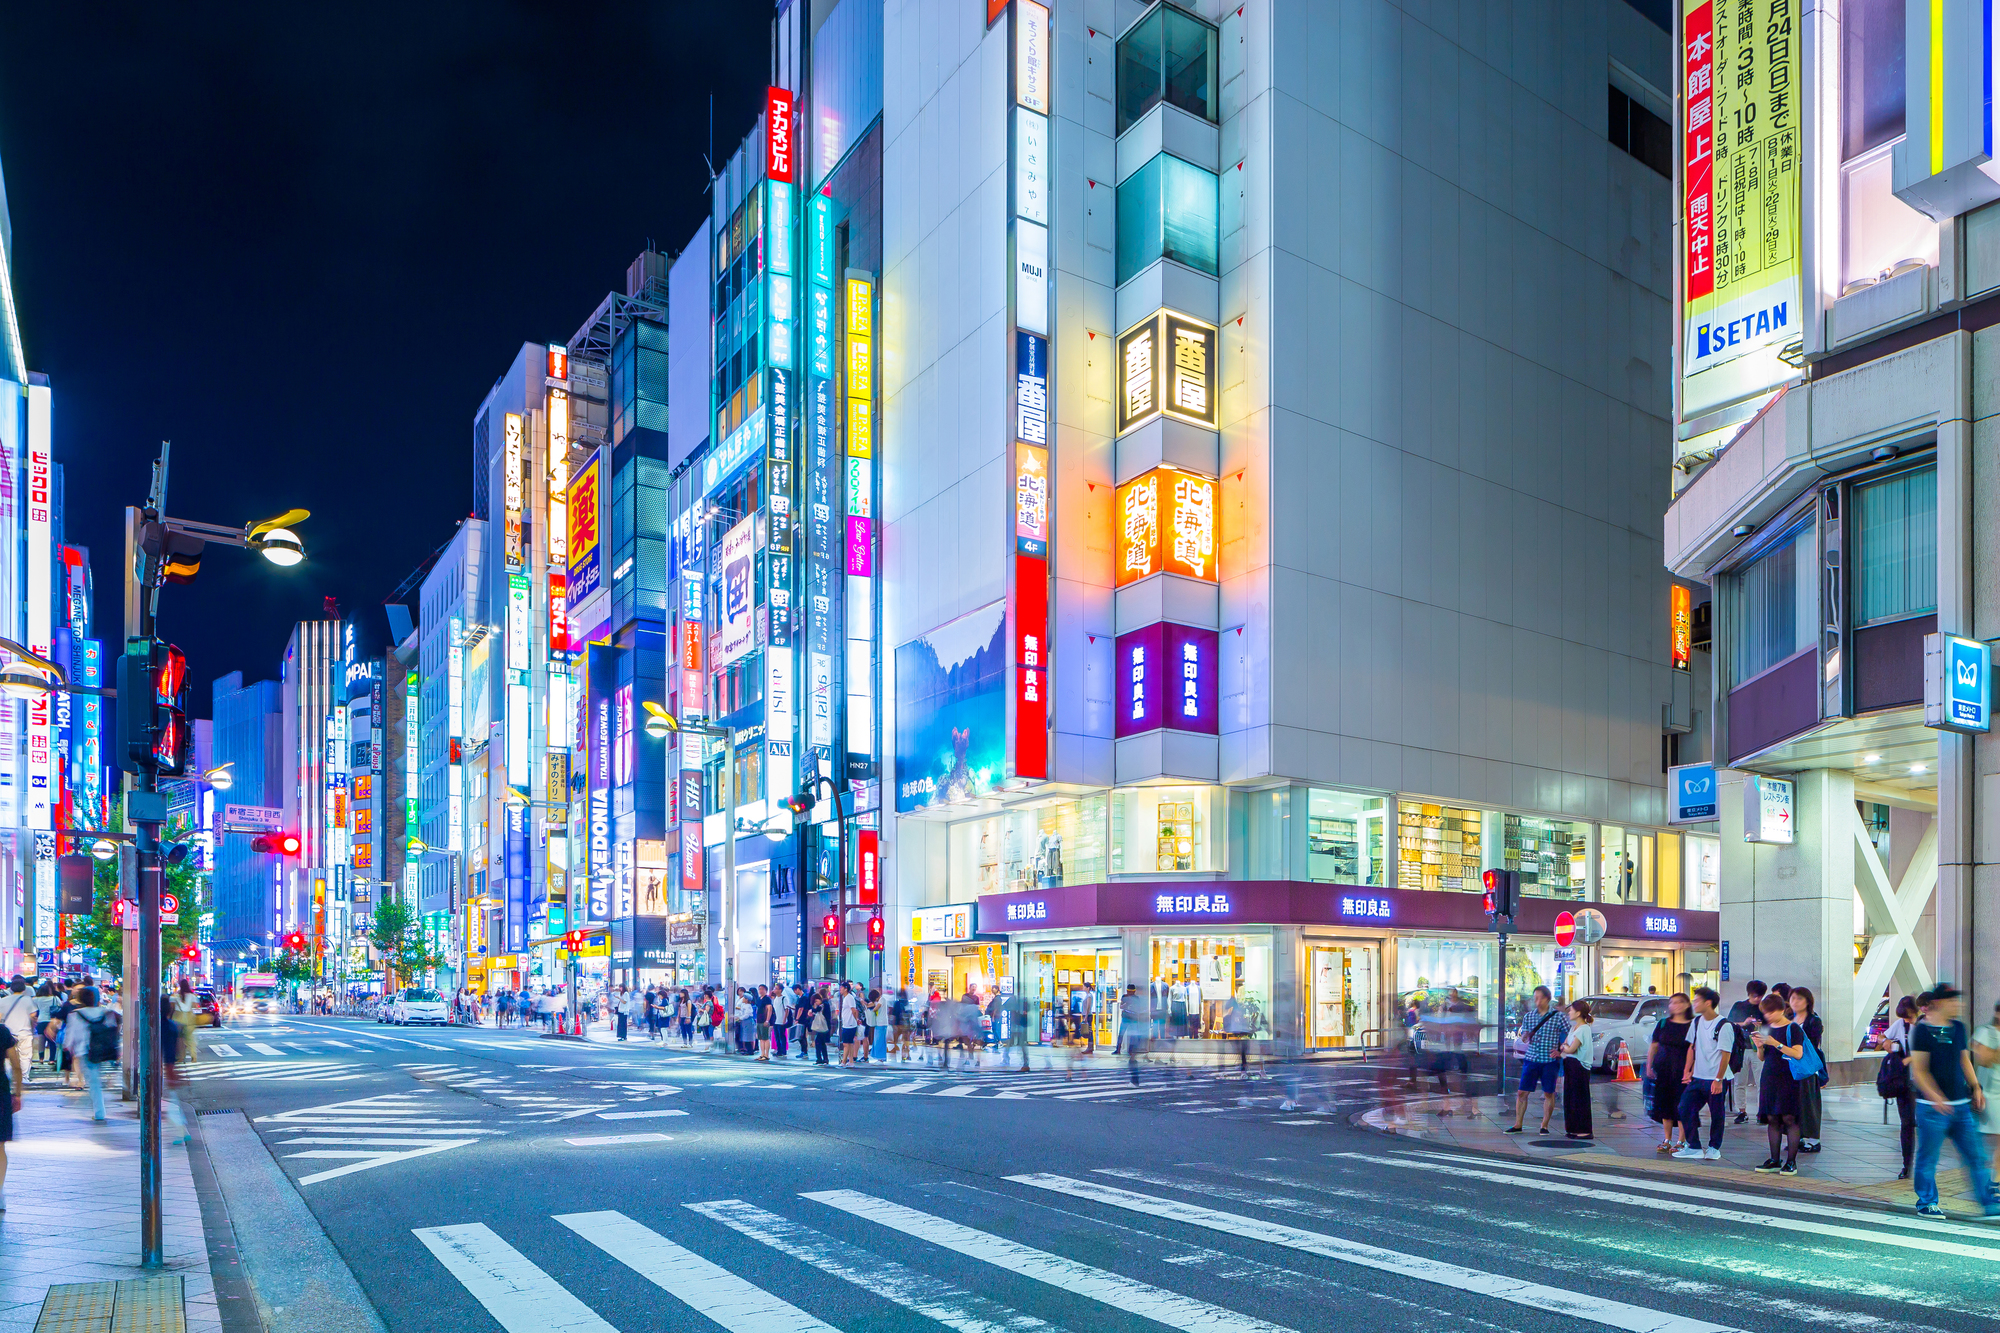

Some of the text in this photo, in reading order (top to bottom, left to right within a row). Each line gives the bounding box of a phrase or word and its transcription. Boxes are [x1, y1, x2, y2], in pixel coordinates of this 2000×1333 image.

[772, 100, 788, 173] アカネビル
[1780, 131, 1793, 174] 休業日
[1021, 262, 1042, 278] MUJI
[32, 451, 47, 504] ビックロ
[571, 472, 595, 559] 薬
[1019, 475, 1038, 529] 北海道
[1127, 486, 1150, 568] 北海道
[1176, 481, 1204, 567] 北海道
[508, 556, 519, 564] 7F
[1024, 541, 1038, 553] 4F
[73, 584, 81, 686] MEGANE TOP SHINJUK
[551, 597, 565, 638] ガスト
[1024, 634, 1038, 702] 無印良品
[1132, 647, 1145, 719] 無印良品
[1183, 643, 1198, 717] 無印良品
[408, 701, 417, 743] 三井住友銀行
[600, 703, 608, 780] LEGWEAR ITALIAN
[770, 742, 790, 756] AX
[229, 806, 281, 819] 新宿三丁目西
[686, 777, 700, 811] HIS
[1764, 792, 1790, 804] レストラン街
[686, 832, 699, 880] Hawaii
[1007, 901, 1046, 921] 無印良品
[1156, 894, 1230, 913] 無印良品
[1342, 897, 1391, 918] 無印良品
[1645, 916, 1677, 933] 無印良品
